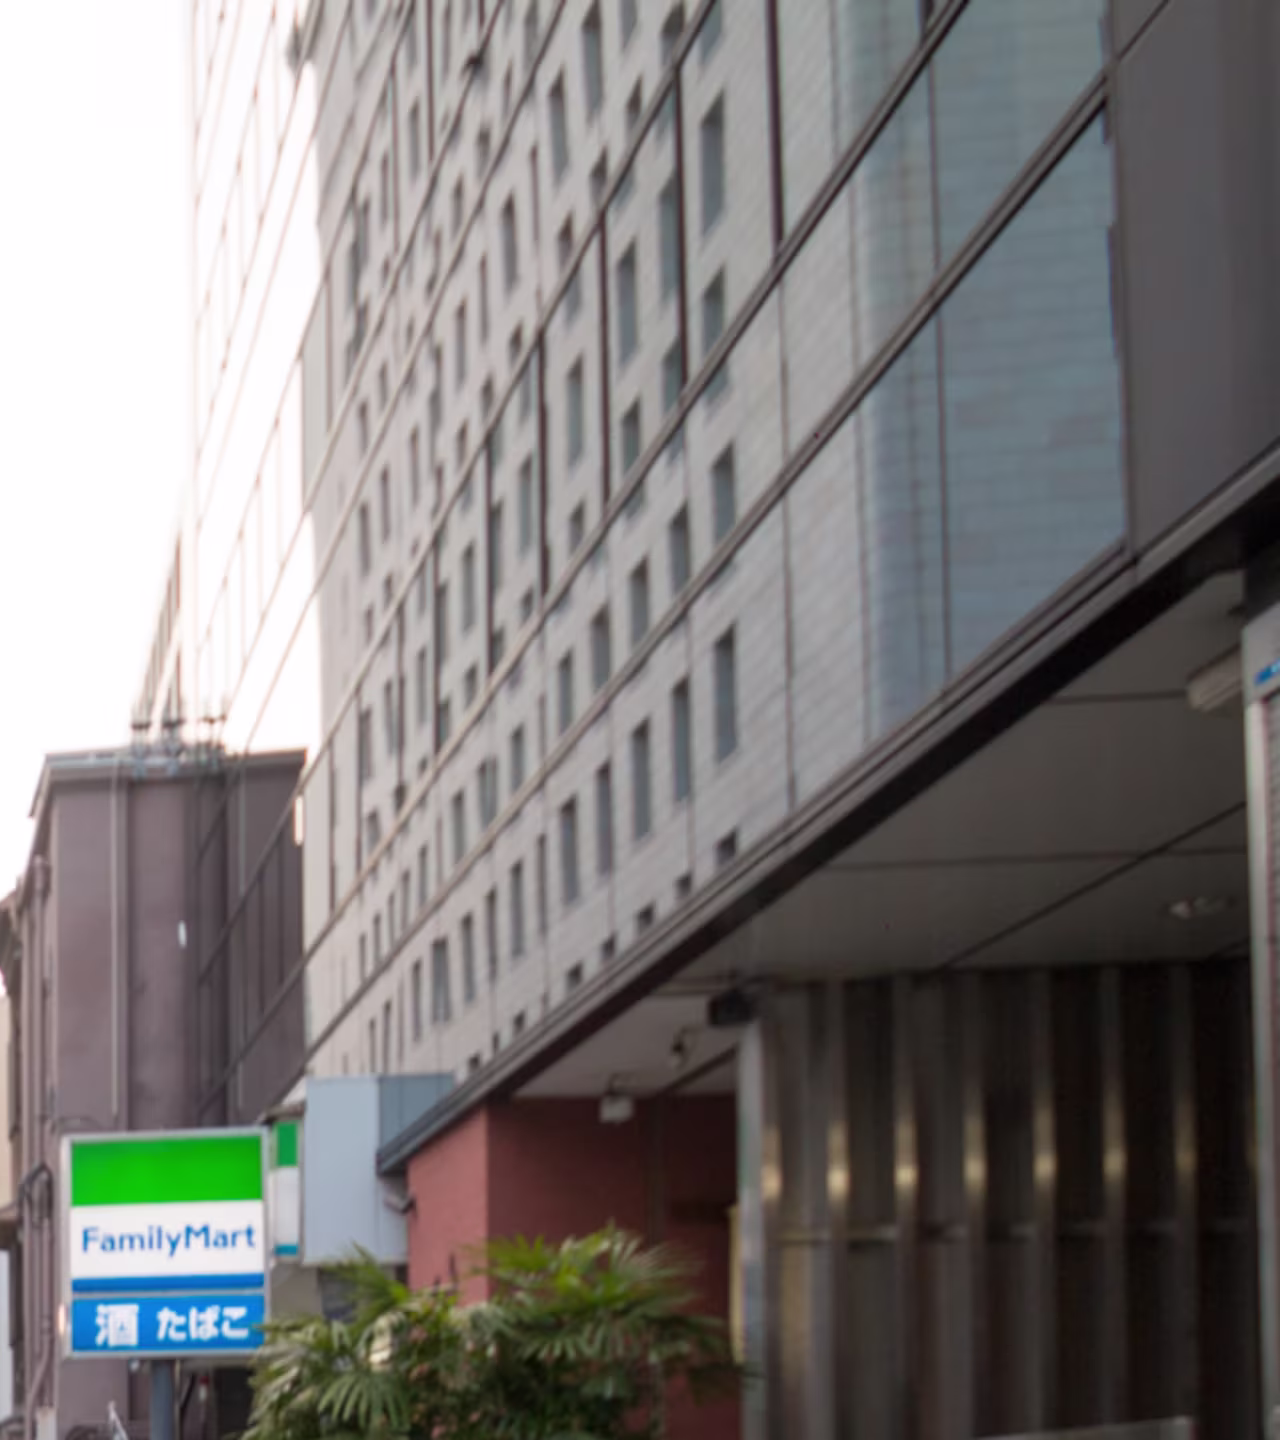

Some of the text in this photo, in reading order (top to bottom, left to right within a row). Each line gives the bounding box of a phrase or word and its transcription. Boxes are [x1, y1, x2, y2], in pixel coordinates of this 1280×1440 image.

[82, 1223, 256, 1258] FamilyMart
[95, 1303, 249, 1347] 酒 たばこ
